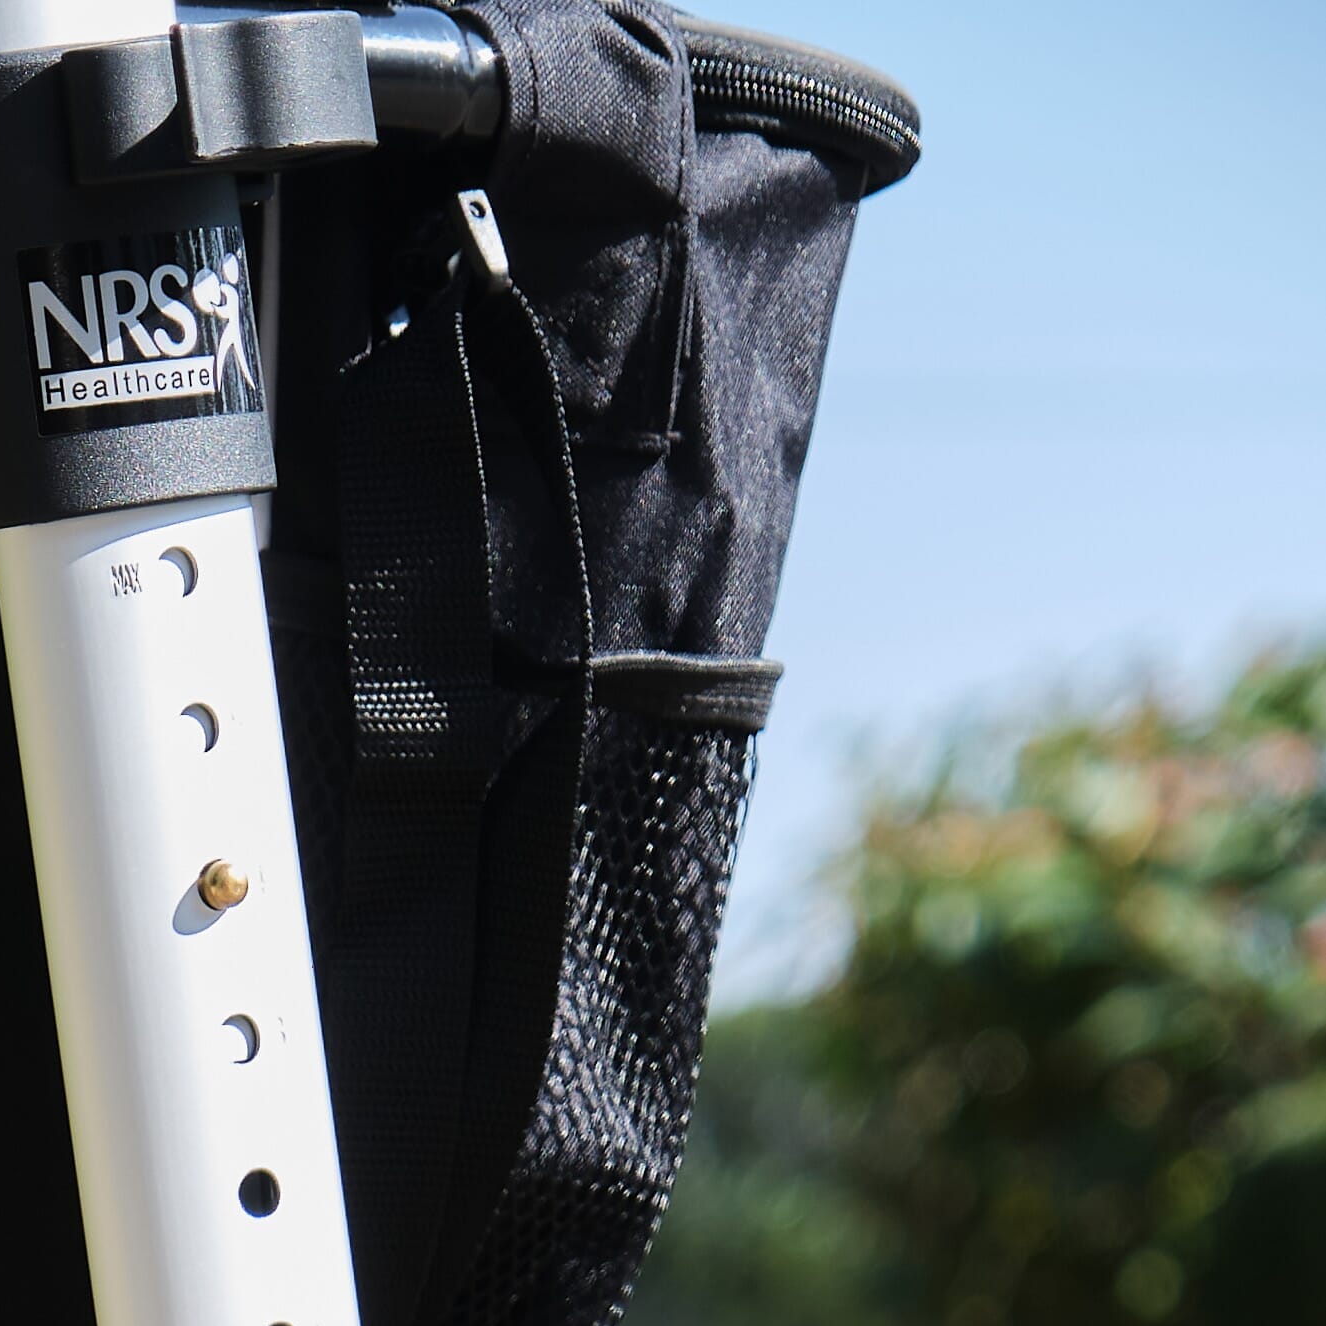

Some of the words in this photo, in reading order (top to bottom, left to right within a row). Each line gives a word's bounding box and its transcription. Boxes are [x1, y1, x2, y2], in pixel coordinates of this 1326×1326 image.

[28, 264, 198, 369] NRS
[44, 367, 211, 405] Healthcare
[110, 562, 142, 597] MAX
